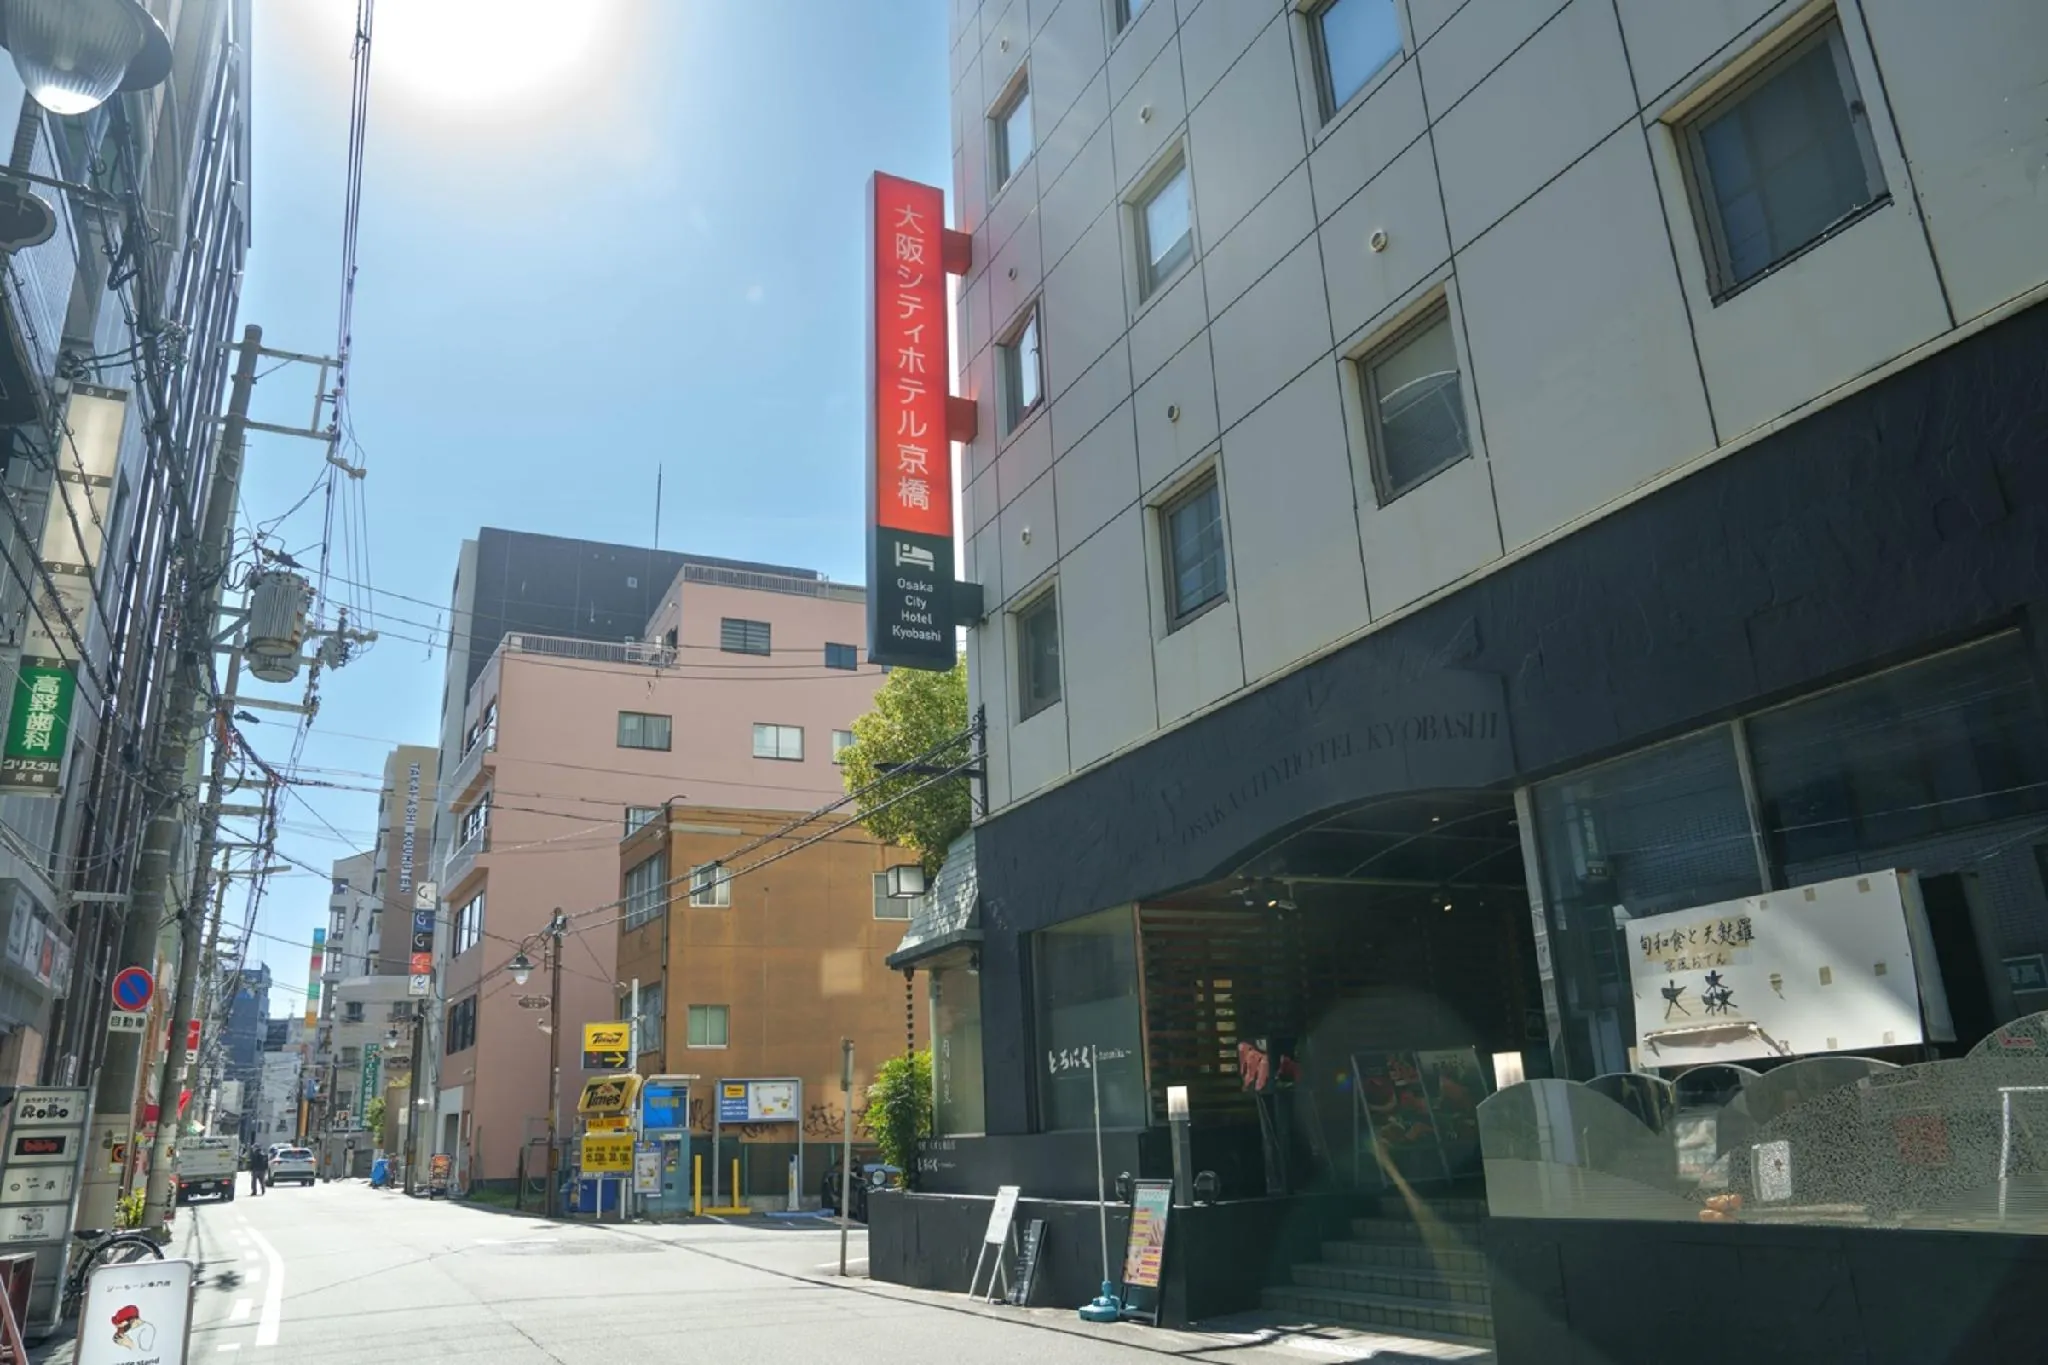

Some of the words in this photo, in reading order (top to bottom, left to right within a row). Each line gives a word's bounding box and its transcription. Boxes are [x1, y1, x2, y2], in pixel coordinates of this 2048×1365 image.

[895, 204, 928, 510] 大阪シティホテル京橋
[897, 577, 934, 593] Osaka
[905, 594, 927, 610] City
[901, 609, 933, 626] Hotel
[892, 624, 942, 643] Kyobashi
[1367, 711, 1498, 750] KYOBASHI
[1660, 969, 1738, 1019] 大森
[110, 1015, 146, 1029] 自動車
[586, 1082, 624, 1109] Times
